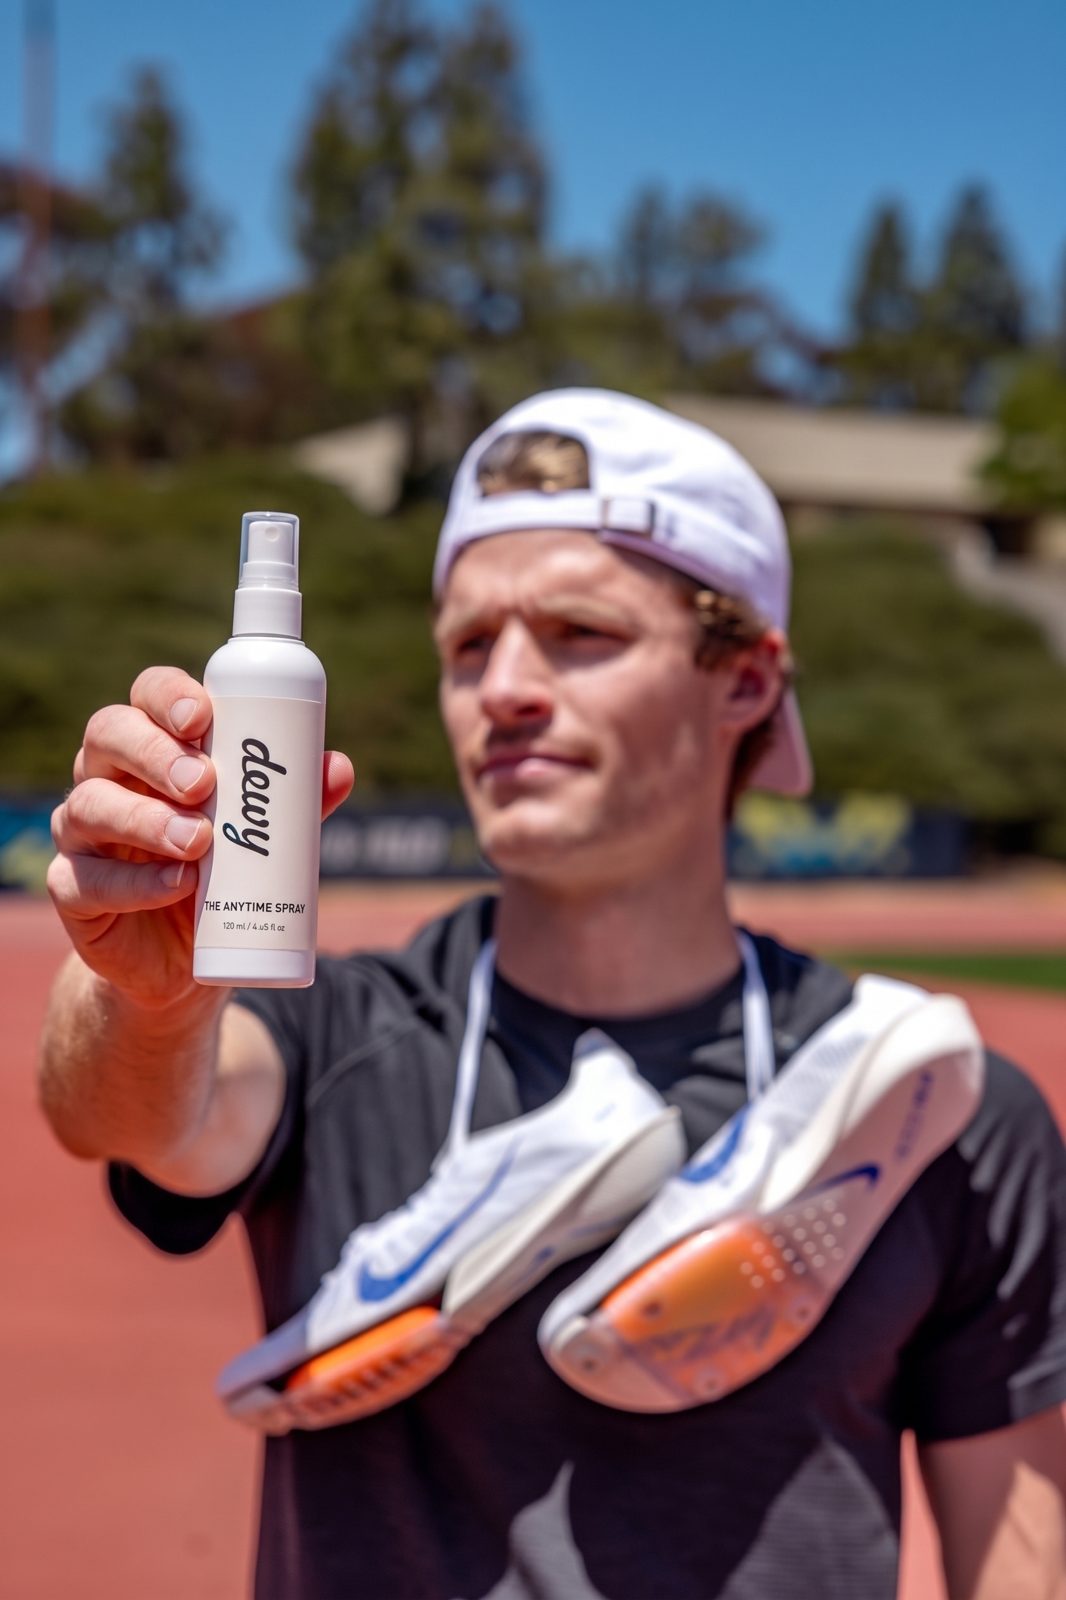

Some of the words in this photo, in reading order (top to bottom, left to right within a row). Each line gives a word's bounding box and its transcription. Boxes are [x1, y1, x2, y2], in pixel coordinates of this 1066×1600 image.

[222, 738, 287, 857] dewy
[205, 901, 221, 911] THE
[223, 902, 273, 912] ANYTIME
[275, 904, 306, 914] SPRAY
[223, 922, 235, 930] 120
[236, 922, 246, 930] ml
[270, 923, 276, 931] fl
